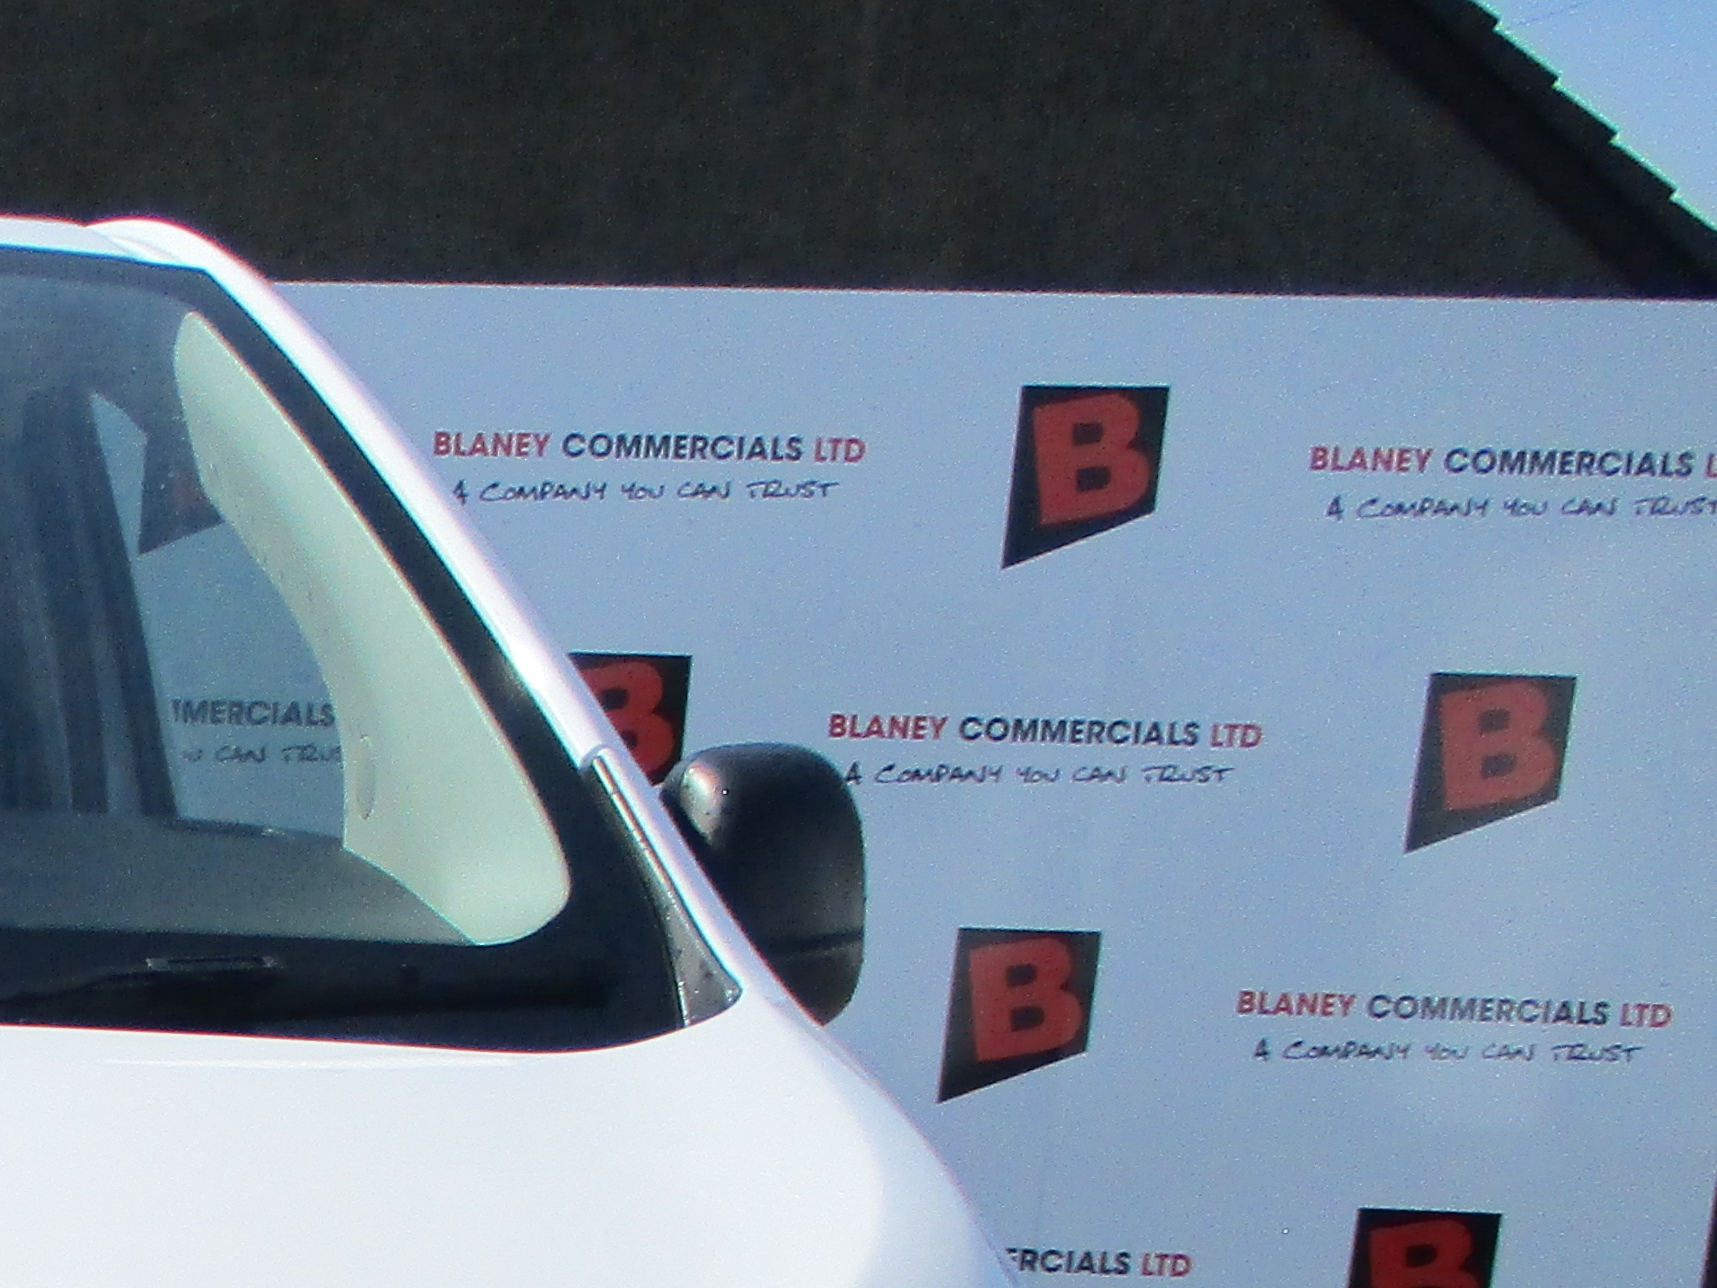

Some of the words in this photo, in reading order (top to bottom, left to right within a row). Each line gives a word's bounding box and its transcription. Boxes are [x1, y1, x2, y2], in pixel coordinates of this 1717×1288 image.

[432, 431, 550, 457] BLANEY
[563, 432, 803, 462] COMMERCIALS
[813, 437, 865, 463] LTD
[1034, 394, 1150, 525] B
[1308, 445, 1432, 473] BLANEY
[1443, 447, 1694, 477] COMMERCIALS
[479, 481, 606, 501] COMPANY
[678, 481, 729, 500] CAN
[745, 480, 840, 500] TRUST
[1357, 497, 1488, 519] COMPANY
[1561, 498, 1617, 517] CAN
[171, 699, 336, 727] MERCIALS
[827, 713, 949, 740] BLANEY
[958, 716, 1201, 747] COMMERCIALS
[1209, 723, 1263, 749] LTD
[1442, 681, 1555, 810] B
[874, 764, 1003, 785] COMPANY
[1072, 764, 1126, 784] CAN
[1141, 762, 1236, 783] TRUST
[969, 934, 1084, 1062] B
[1236, 990, 1356, 1017] BLANEY
[1367, 994, 1610, 1026] COMMERCIALS
[1620, 1002, 1673, 1027] LTD
[1282, 1040, 1411, 1060] COMPANY
[1482, 1043, 1534, 1061] CAN
[1551, 1043, 1644, 1062] TRUST
[1141, 1252, 1193, 1277] LTD
